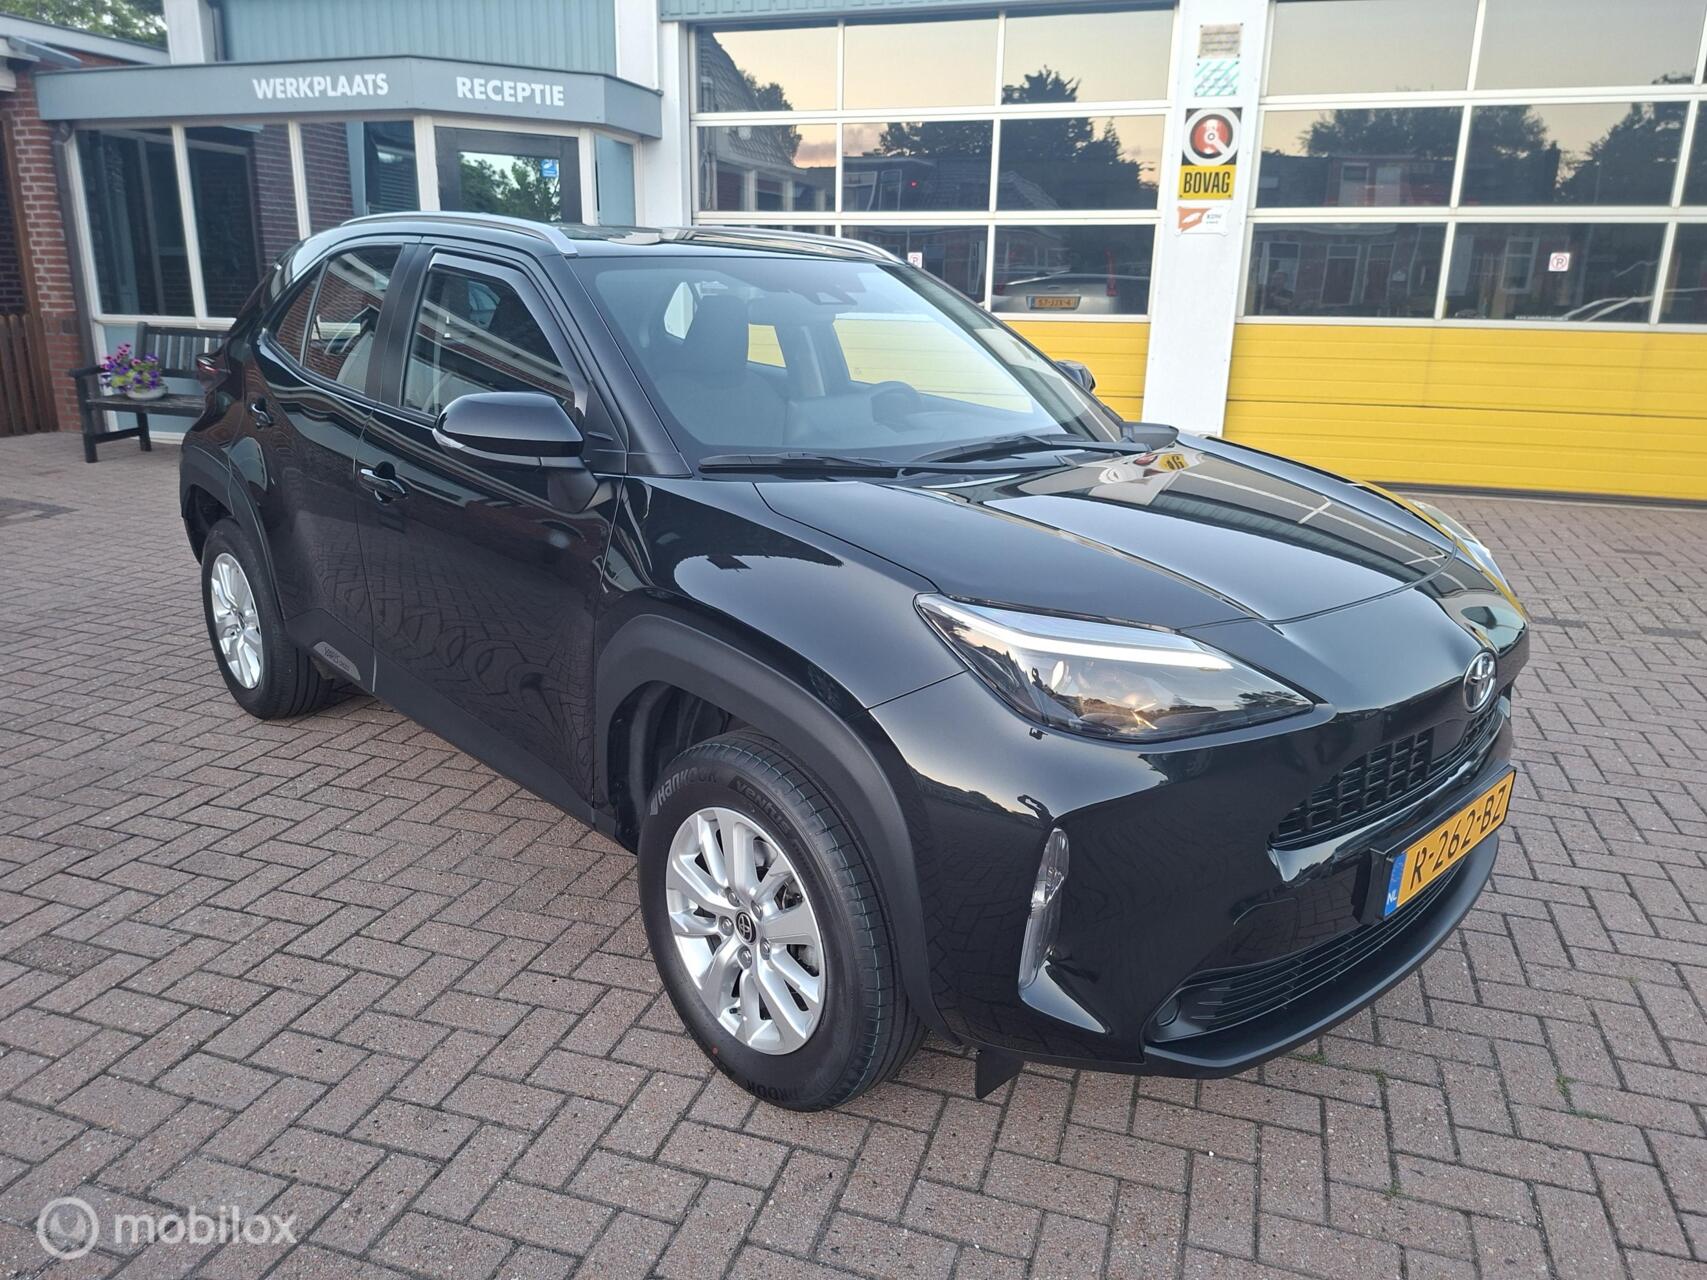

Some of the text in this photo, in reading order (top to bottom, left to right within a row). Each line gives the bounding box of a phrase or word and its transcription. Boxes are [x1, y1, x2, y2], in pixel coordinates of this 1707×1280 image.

[252, 73, 389, 99] WERKPLAATS
[455, 76, 565, 106] RECEPTIE
[1183, 171, 1231, 194] BOVAG
[1409, 783, 1507, 891] R-262-BZ
[1386, 889, 1398, 905] NL
